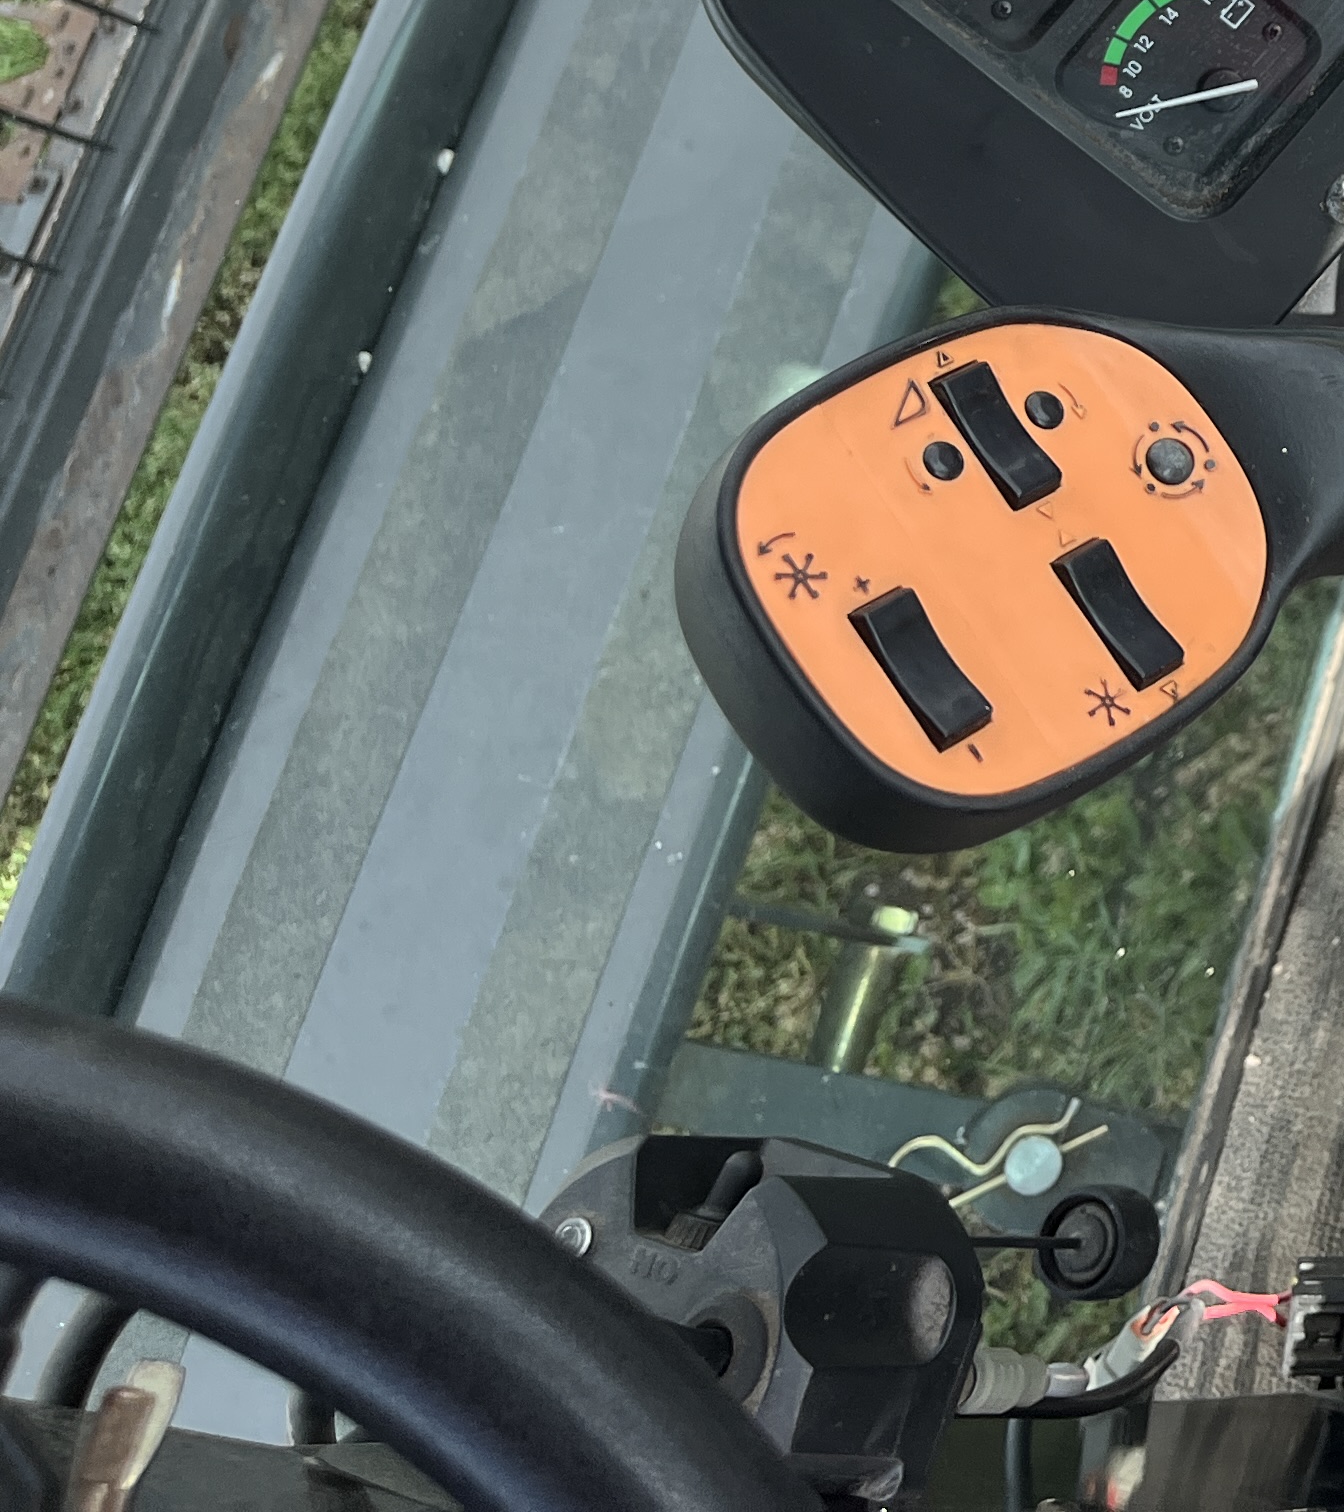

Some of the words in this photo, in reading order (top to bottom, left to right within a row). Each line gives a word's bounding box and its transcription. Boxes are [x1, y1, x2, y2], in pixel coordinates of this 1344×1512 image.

[1158, 6, 1179, 25] 14
[1133, 35, 1155, 53] 12
[1122, 60, 1143, 78] 10
[1118, 85, 1133, 99] 8
